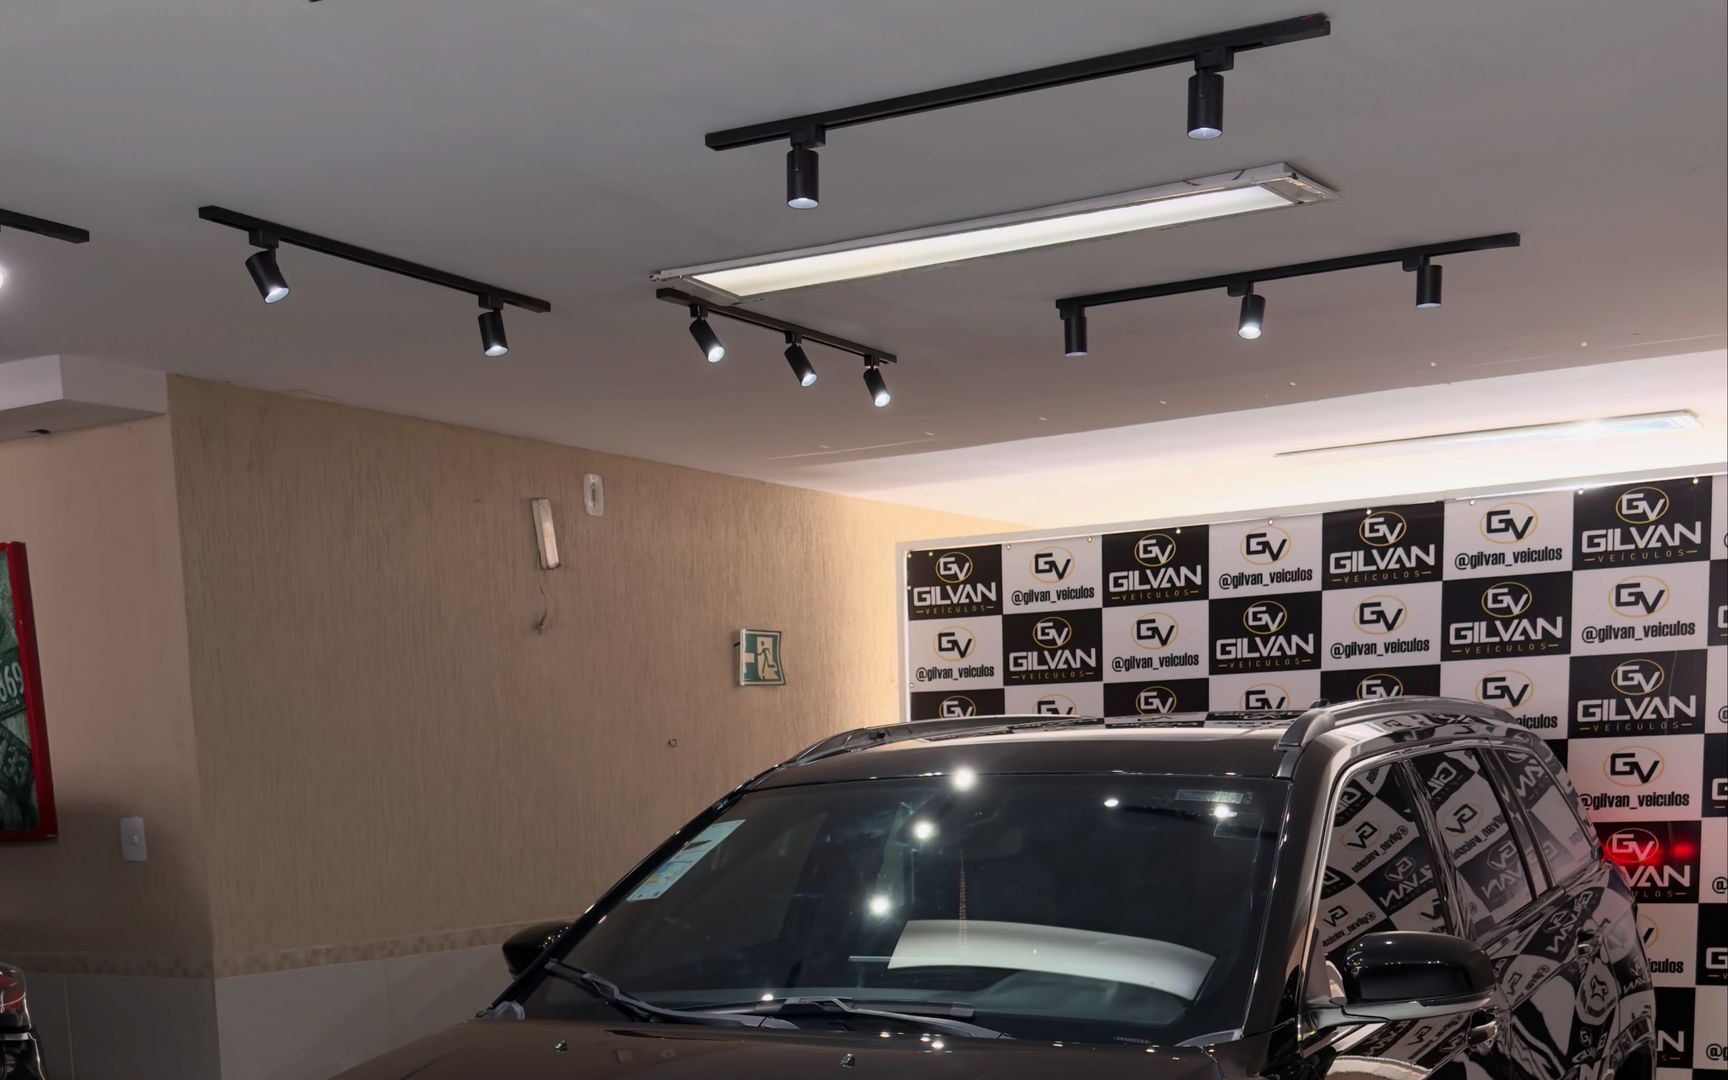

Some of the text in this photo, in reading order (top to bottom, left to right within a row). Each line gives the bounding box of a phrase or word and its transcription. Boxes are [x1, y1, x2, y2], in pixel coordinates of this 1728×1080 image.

[1620, 493, 1665, 521] GV
[1364, 518, 1403, 544] GV
[1487, 510, 1533, 540] GV
[1582, 521, 1701, 553] GILVAN
[1138, 539, 1172, 564] GV
[1245, 533, 1286, 561] GV
[1329, 544, 1435, 574] GILVAN
[1455, 546, 1562, 570] @gilvan_veiculos
[939, 557, 969, 580] GV
[1034, 553, 1071, 580] GV
[1109, 565, 1201, 592] GILVAN
[1219, 568, 1313, 590] @gilvan_veiculos
[913, 582, 996, 606] GILVAN
[1011, 585, 1095, 605] @gilvan_veiculos
[1487, 589, 1528, 614] GV
[1615, 583, 1666, 614] GV
[1247, 606, 1283, 632] GV
[1359, 602, 1403, 631] GV
[1036, 622, 1068, 646] GV
[1136, 619, 1175, 647] GV
[1449, 616, 1562, 645] GILVAN
[1581, 620, 1696, 644] @gilvan_veiculos
[938, 633, 972, 659] GV
[1216, 633, 1314, 660] GILVAN
[1330, 638, 1430, 658] @gilvan_veiculos
[916, 664, 994, 682] @gilvan_veiculos
[1009, 648, 1096, 672] GILVAN
[1112, 653, 1199, 672] @gilvan_veiculos
[1482, 677, 1529, 707] GV
[1616, 665, 1660, 693] GV
[1140, 692, 1173, 713] GV
[1577, 695, 1696, 722] GILVAN
[1610, 753, 1660, 784] GV
[1612, 834, 1655, 861] GV
